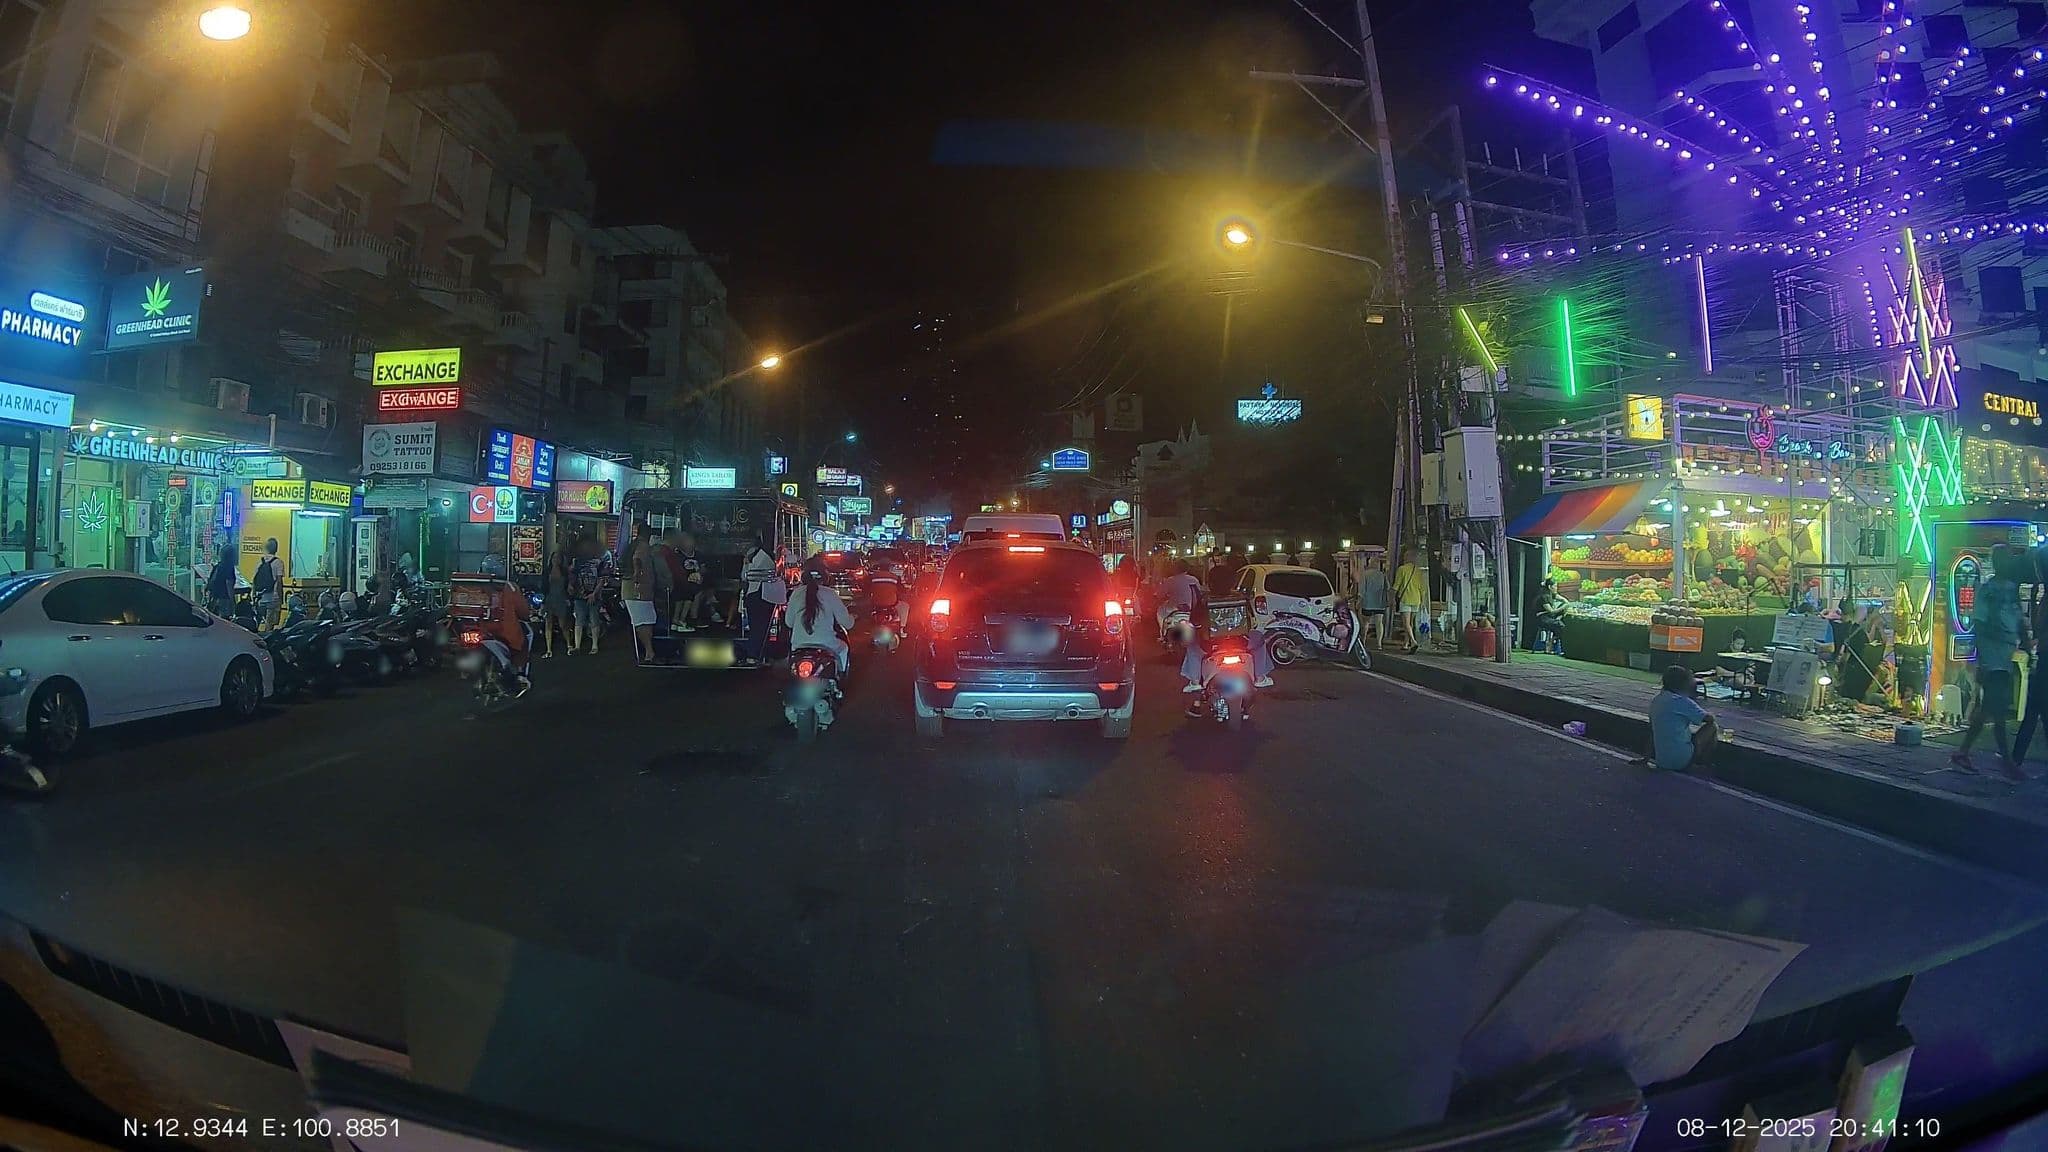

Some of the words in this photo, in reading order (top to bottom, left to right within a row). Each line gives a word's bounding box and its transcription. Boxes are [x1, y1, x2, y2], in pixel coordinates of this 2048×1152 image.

[2, 310, 81, 346] PHARMACY
[116, 319, 162, 335] GREENHEAD
[163, 315, 192, 328] CLINIC
[377, 362, 457, 381] EXCHANGE
[1983, 392, 2040, 417] CENTRAL
[394, 434, 433, 445] SUMIT
[89, 437, 178, 465] GREENHEAD
[180, 450, 224, 469] CLINIC
[393, 447, 432, 456] TATTOO
[1829, 441, 1850, 459] Bar
[370, 461, 427, 471] 0925318166
[254, 486, 304, 498] EXCHANGE
[310, 487, 349, 504] EXCHANGE
